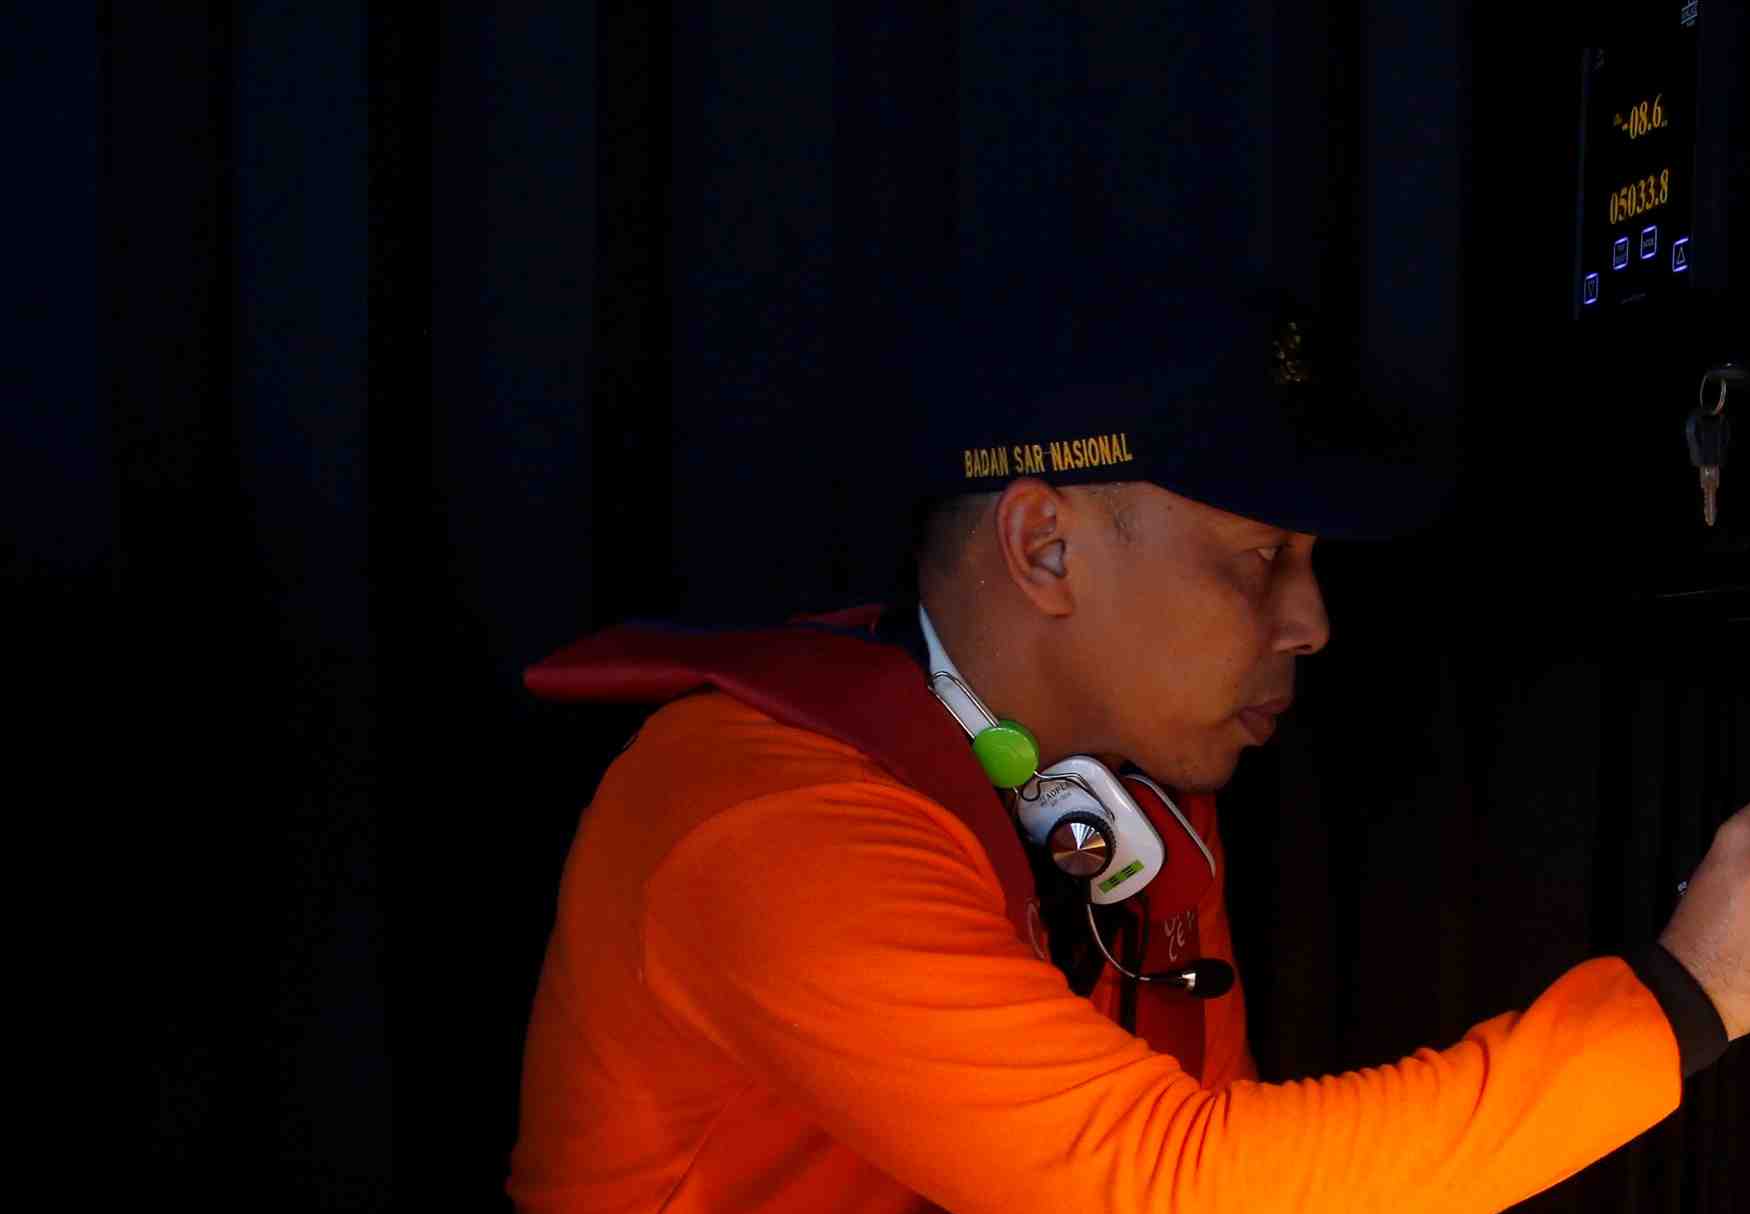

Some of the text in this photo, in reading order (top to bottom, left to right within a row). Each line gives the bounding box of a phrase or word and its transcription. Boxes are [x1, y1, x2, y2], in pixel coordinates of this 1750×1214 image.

[1609, 168, 1670, 224] 05033.8
[964, 432, 1133, 478] BADAN SAR NASIONAL
